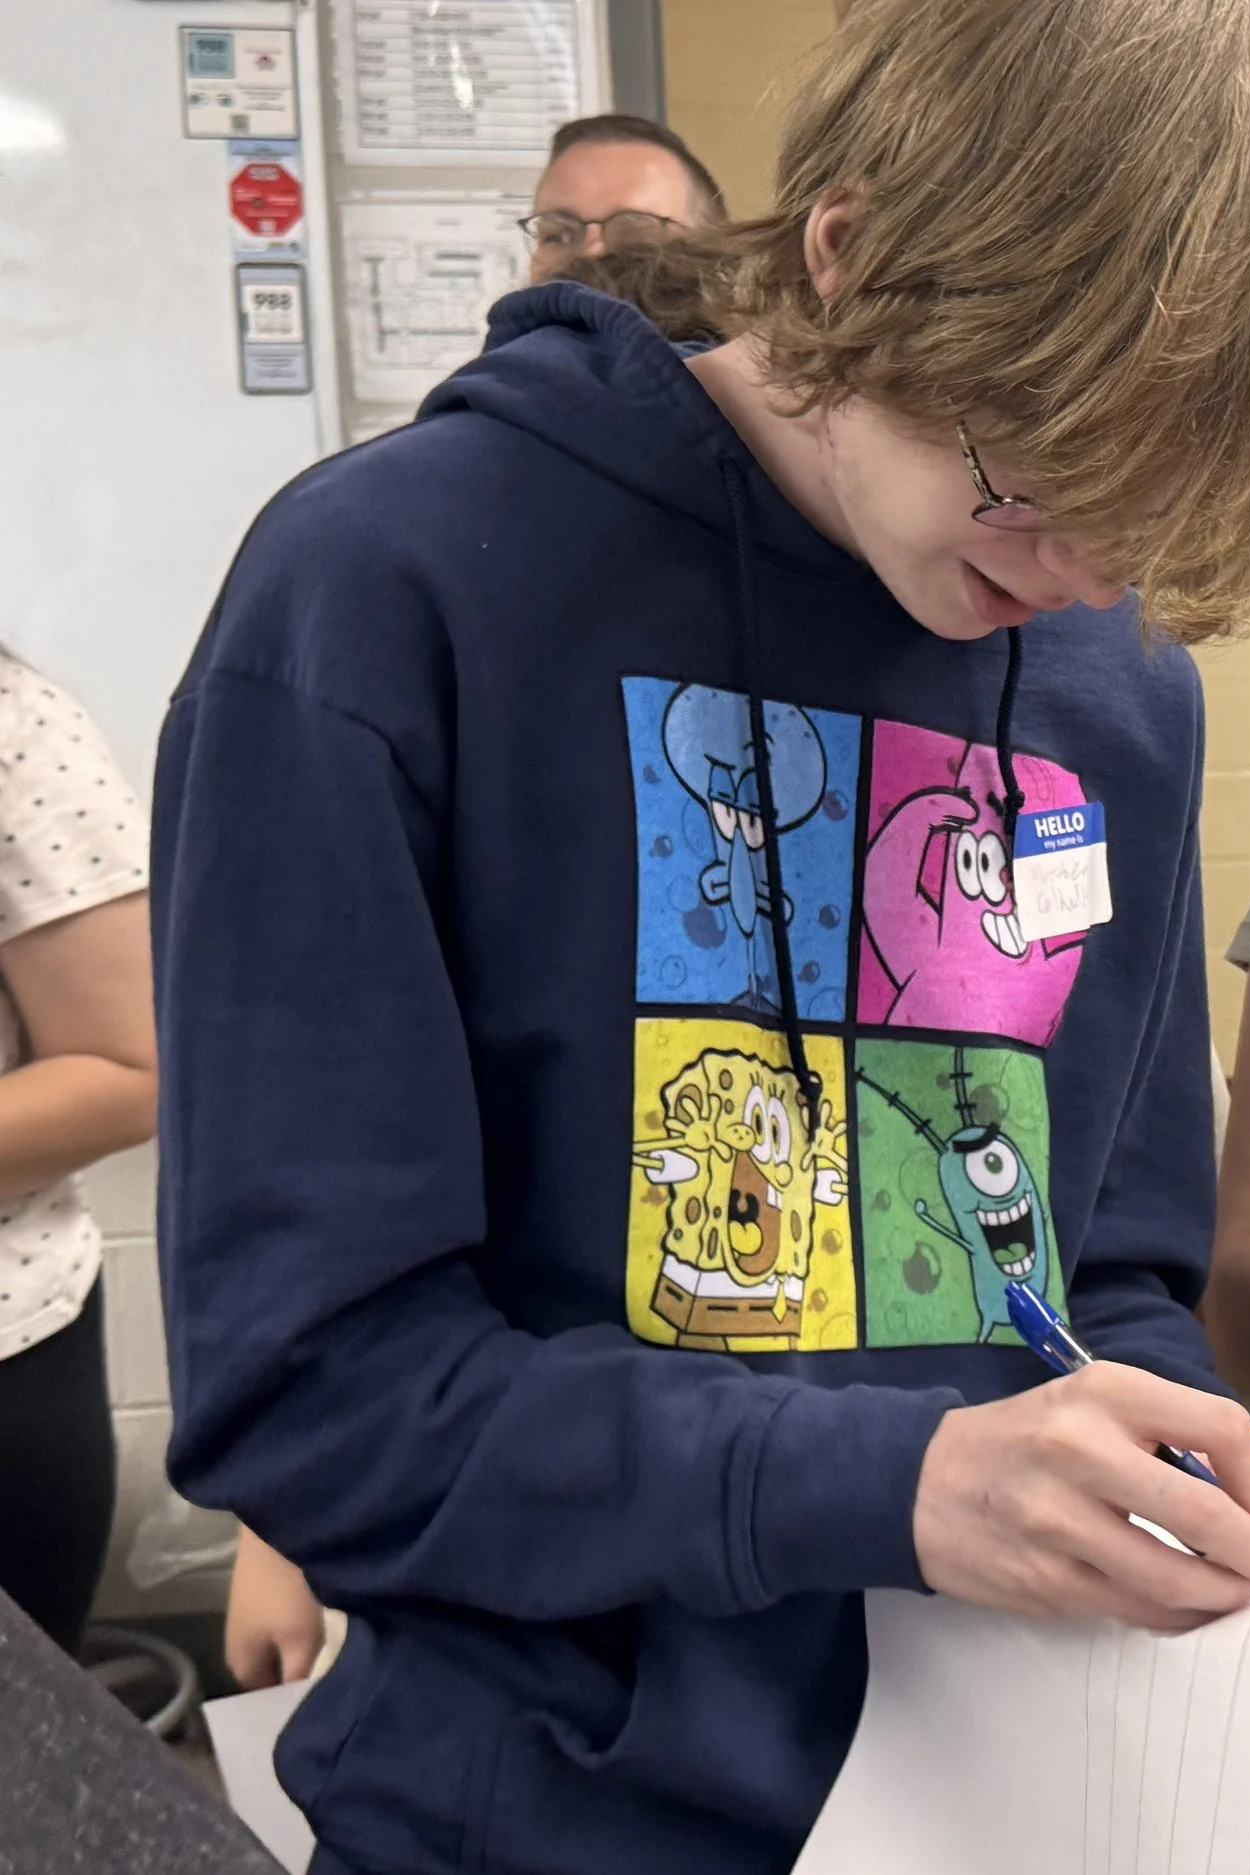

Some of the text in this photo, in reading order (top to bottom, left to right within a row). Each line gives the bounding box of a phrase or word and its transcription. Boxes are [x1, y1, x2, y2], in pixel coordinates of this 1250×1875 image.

[1034, 812, 1086, 839] HELLO
[1043, 840, 1056, 851] my
[1056, 836, 1077, 848] name
